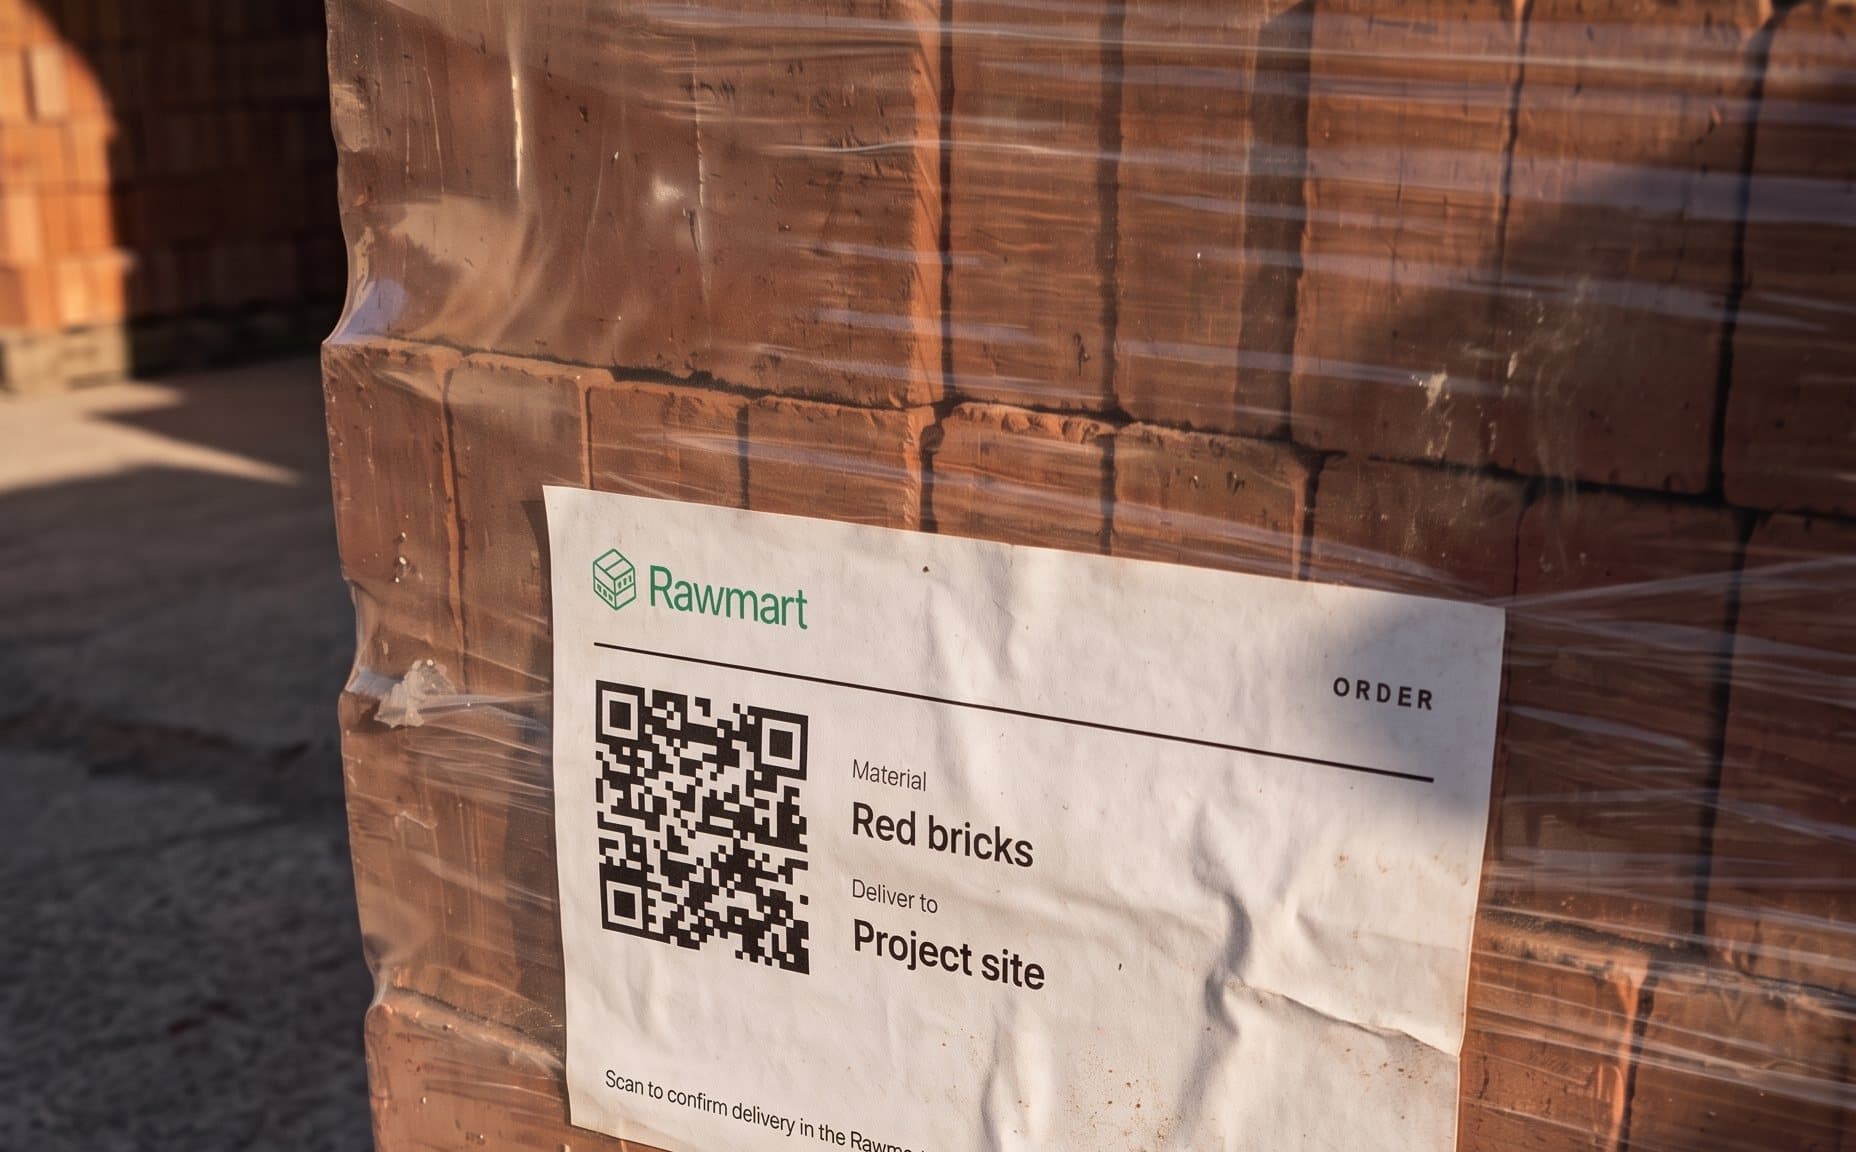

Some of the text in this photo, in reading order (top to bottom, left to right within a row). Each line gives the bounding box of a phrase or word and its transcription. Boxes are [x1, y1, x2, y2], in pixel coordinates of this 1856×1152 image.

[650, 564, 808, 630] Rawmart
[1333, 677, 1433, 710] ORDER
[852, 758, 927, 792] Material
[852, 801, 1034, 867] Red bricks
[852, 878, 938, 914] Deliver to
[853, 918, 1045, 990] Project site
[605, 1069, 644, 1096] Scan
[647, 1080, 664, 1100] to
[667, 1088, 728, 1117] confirm
[732, 1102, 796, 1137] delivery
[799, 1117, 815, 1139] in
[818, 1123, 846, 1146] the
